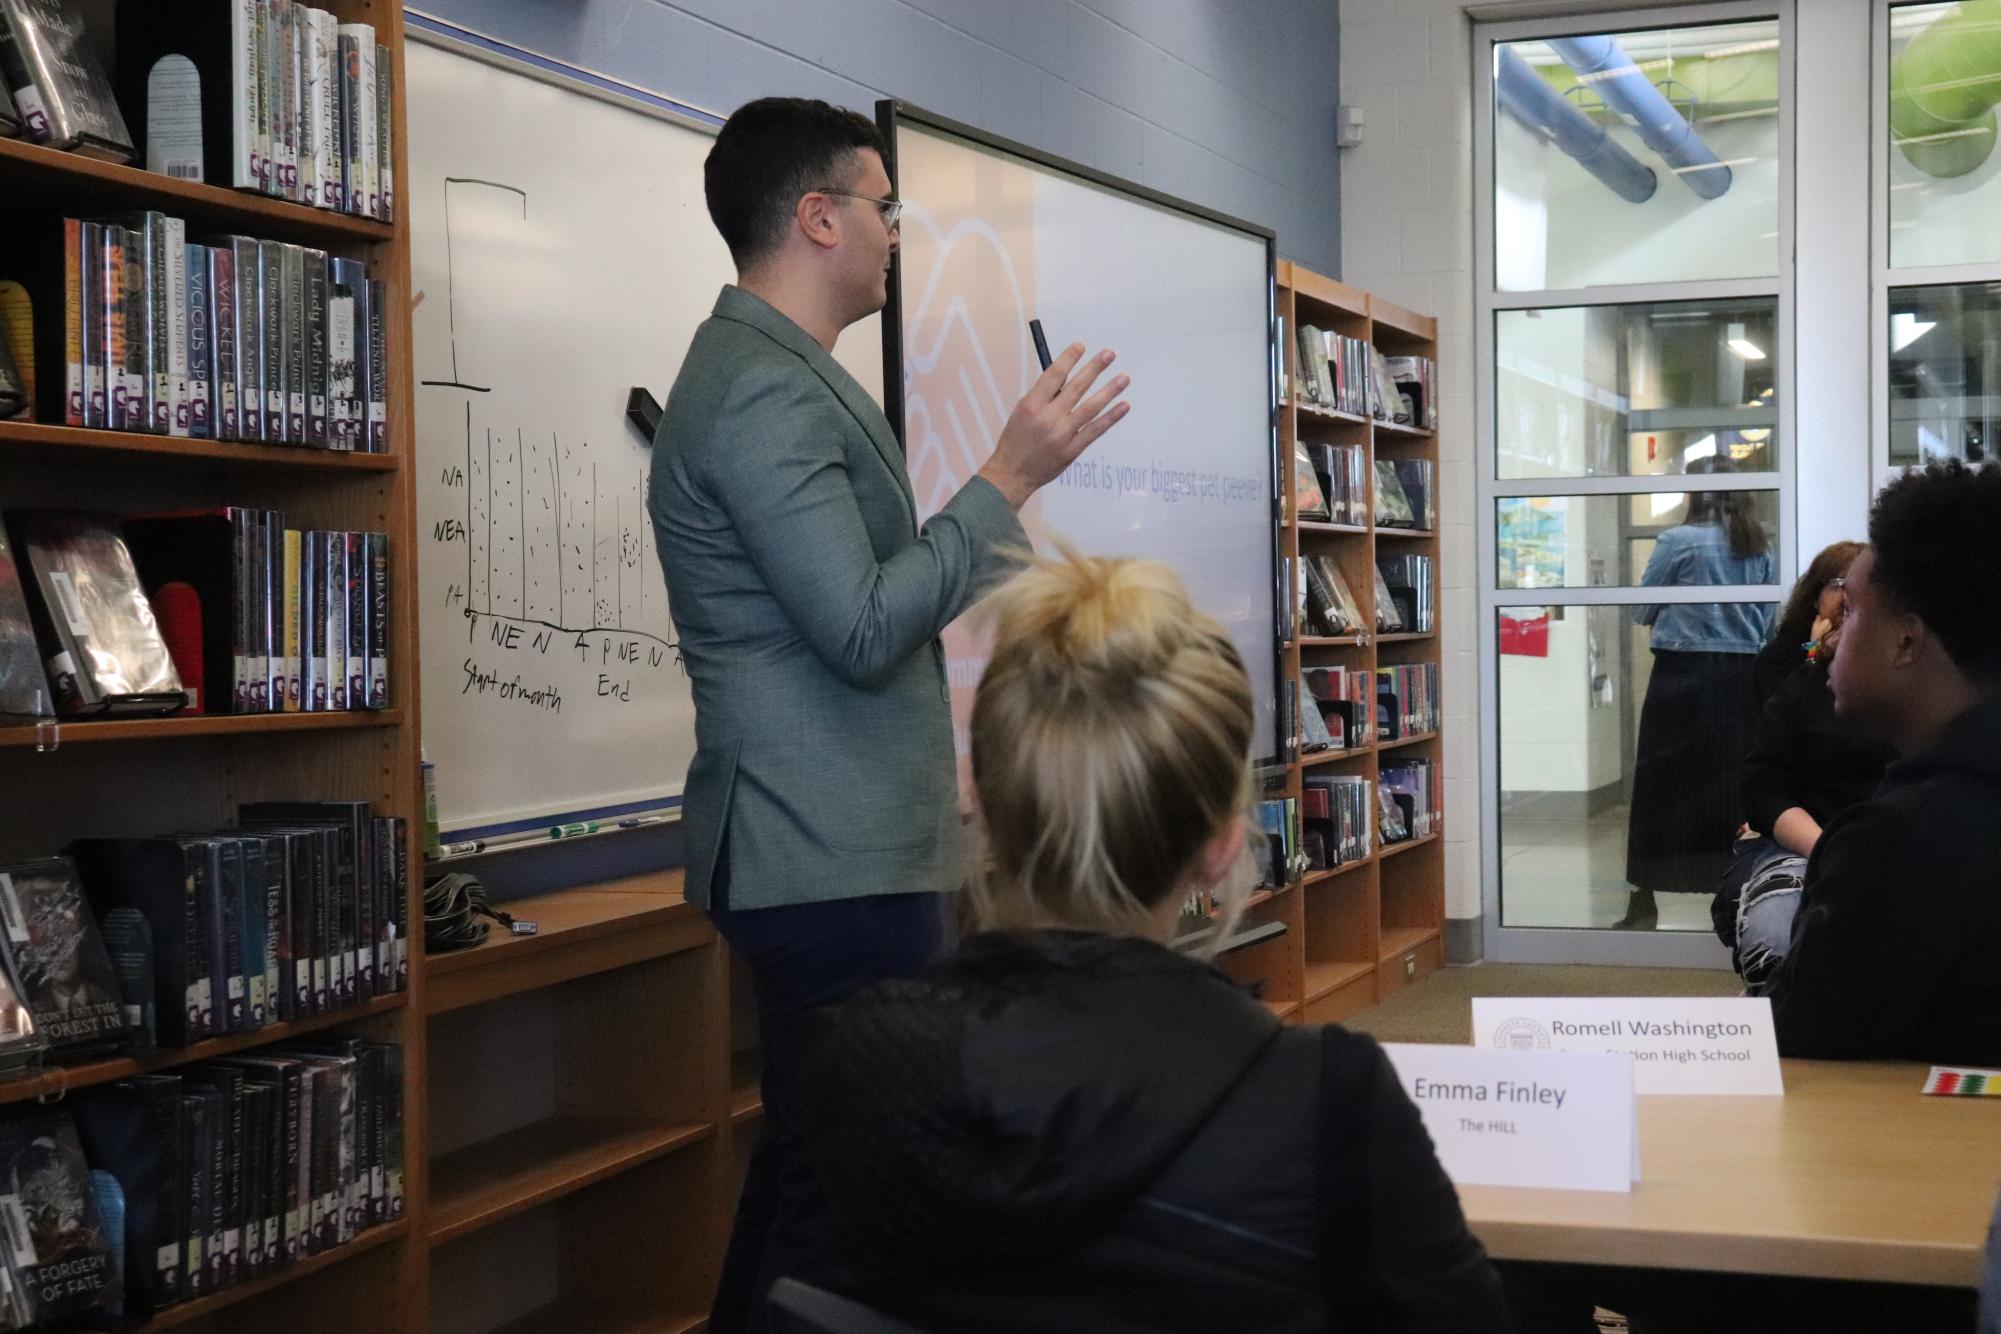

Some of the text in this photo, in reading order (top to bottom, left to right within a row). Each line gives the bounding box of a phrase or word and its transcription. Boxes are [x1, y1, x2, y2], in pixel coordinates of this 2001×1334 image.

[191, 273, 205, 350] VICIOUS
[218, 279, 234, 363] WICKED
[244, 266, 256, 388] Clockwork Angel
[269, 267, 280, 392] Clockwork Prince
[291, 270, 302, 393] Clockwork Prince
[309, 277, 323, 395] Lady Midnig
[373, 373, 382, 401] WOR
[441, 465, 463, 488] NA
[1102, 456, 1112, 490] is
[1116, 465, 1148, 497] your
[1151, 459, 1197, 502] biggest
[433, 518, 466, 544] NEA
[375, 572, 385, 629] BEASTS
[603, 638, 612, 665] P
[648, 646, 663, 667] N
[597, 673, 631, 702] End
[98, 1002, 119, 1015] THE
[40, 1013, 123, 1038] FOREST IN
[1552, 1020, 1622, 1036] Romell
[1628, 1020, 1753, 1040] Washington
[1662, 1049, 1697, 1064] High
[1701, 1049, 1751, 1062] School
[1415, 1077, 1567, 1110] Emma Finley
[287, 1075, 298, 1165] FURYBORN
[1460, 1117, 1518, 1134] The HILL
[25, 1254, 107, 1285] A FORGERY
[42, 1273, 104, 1302] OF FATE
